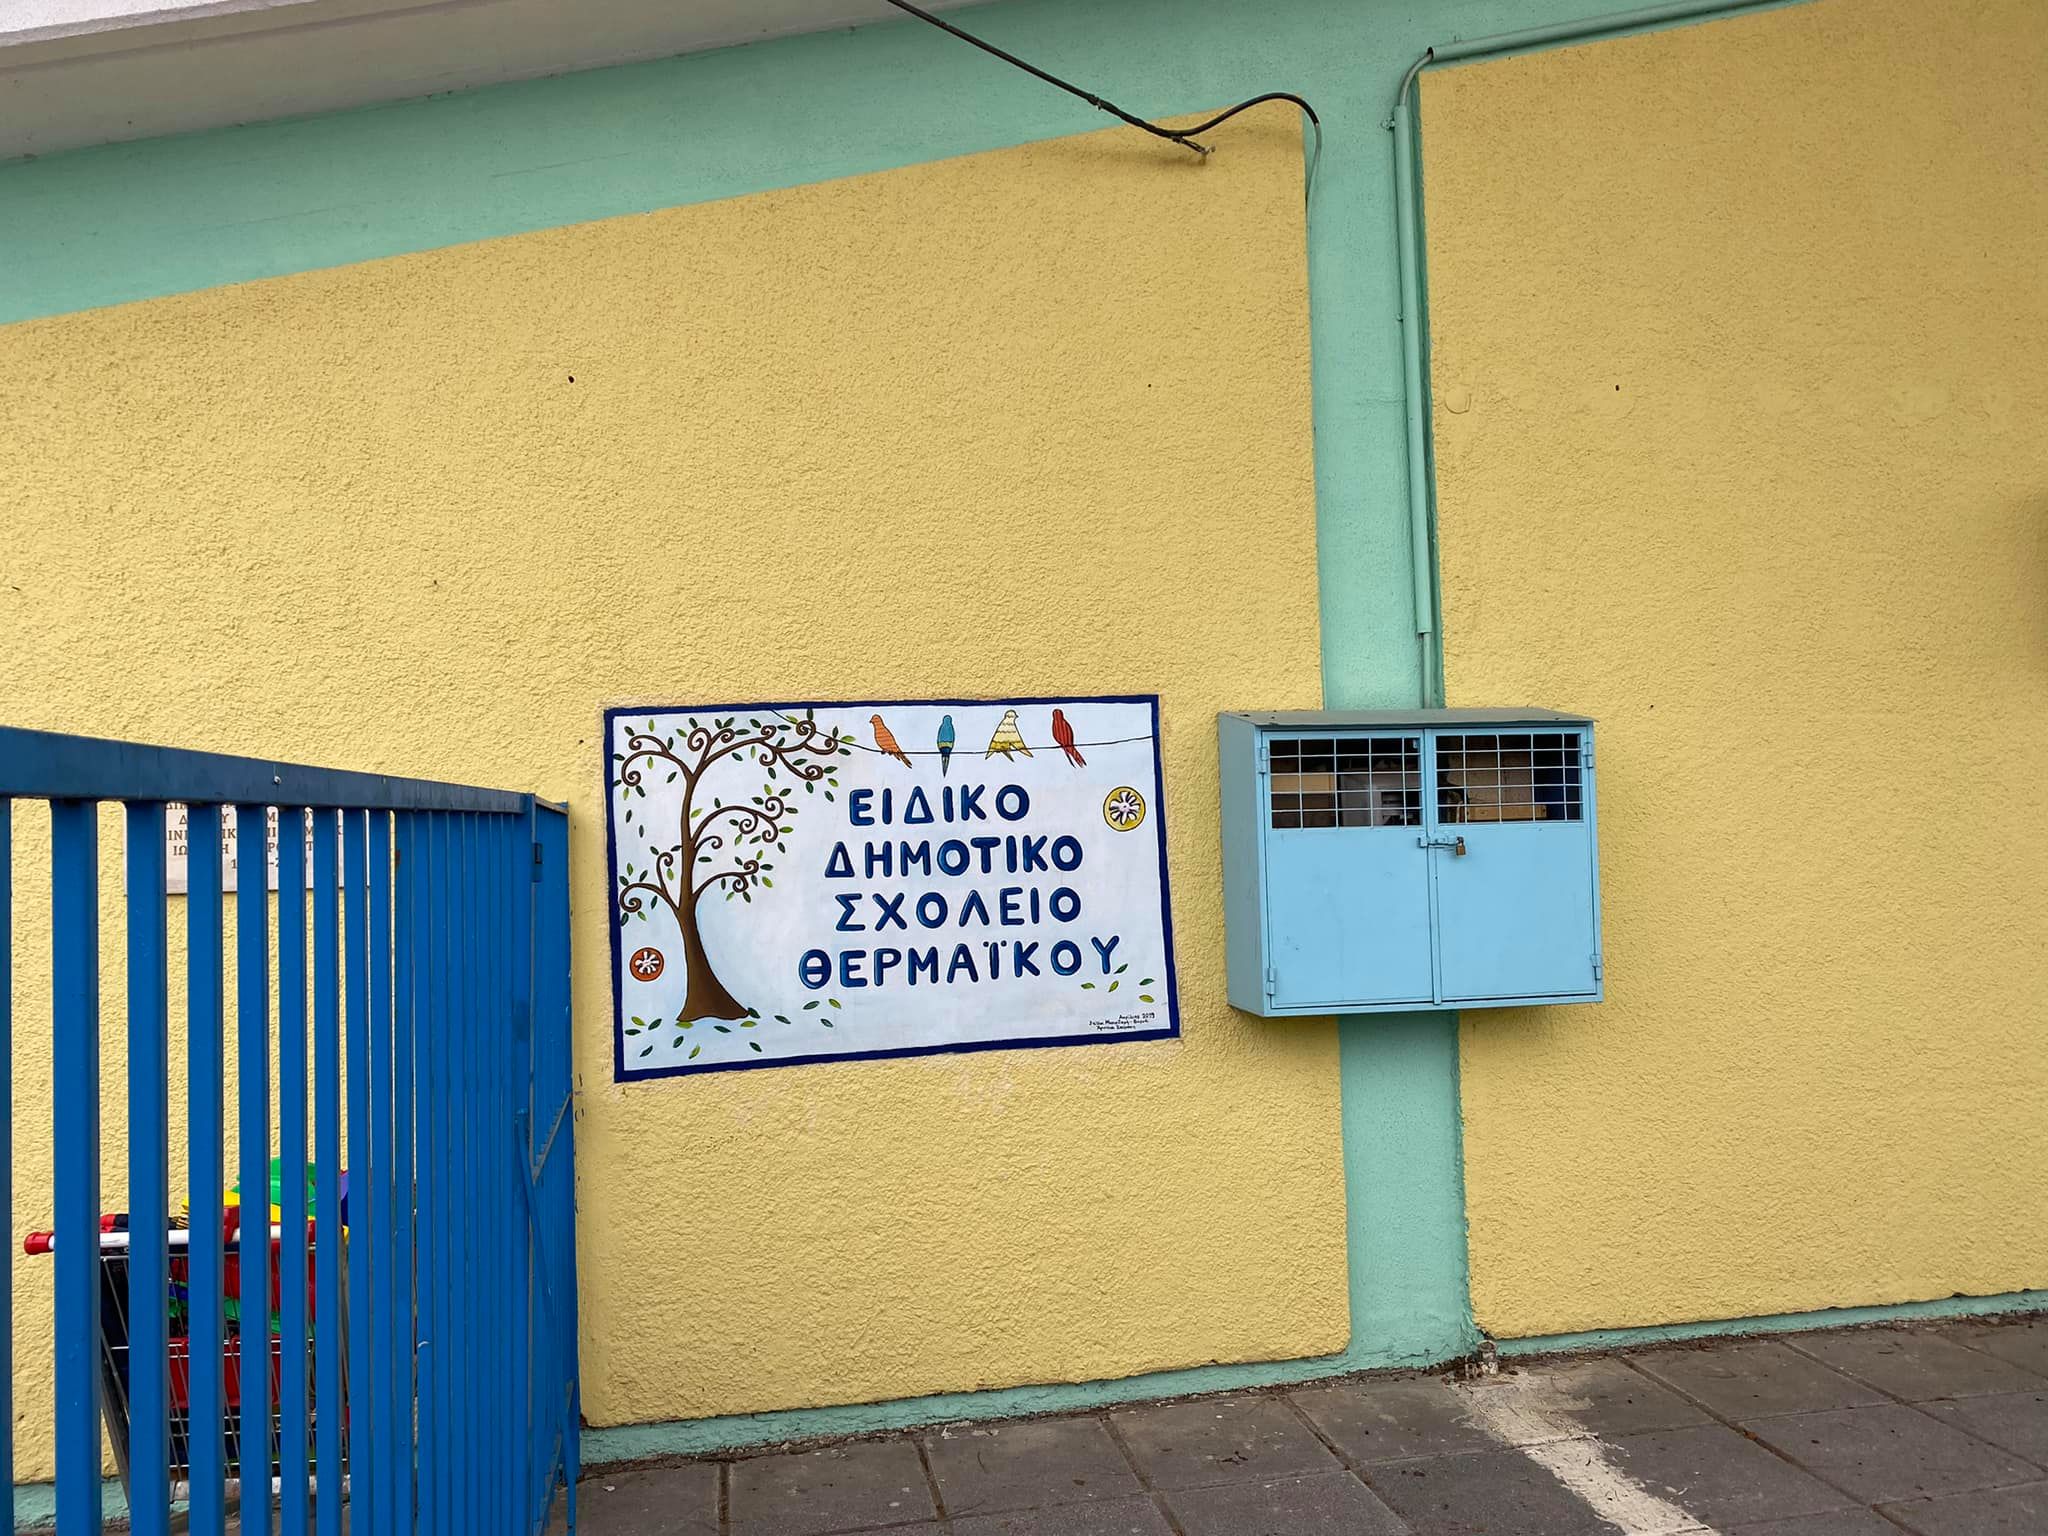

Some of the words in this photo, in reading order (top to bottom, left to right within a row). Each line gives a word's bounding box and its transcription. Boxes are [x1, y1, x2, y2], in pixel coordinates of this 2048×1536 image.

[849, 784, 1030, 827] ΕΙΔΙΚΟ
[824, 835, 1083, 879] ΔΗΜΟΤΙΚΟ
[835, 886, 1081, 932] ΣΧΟΛΕΙΟ
[798, 935, 1120, 990] ΘΕΡΜΑΪΚΟΥ
